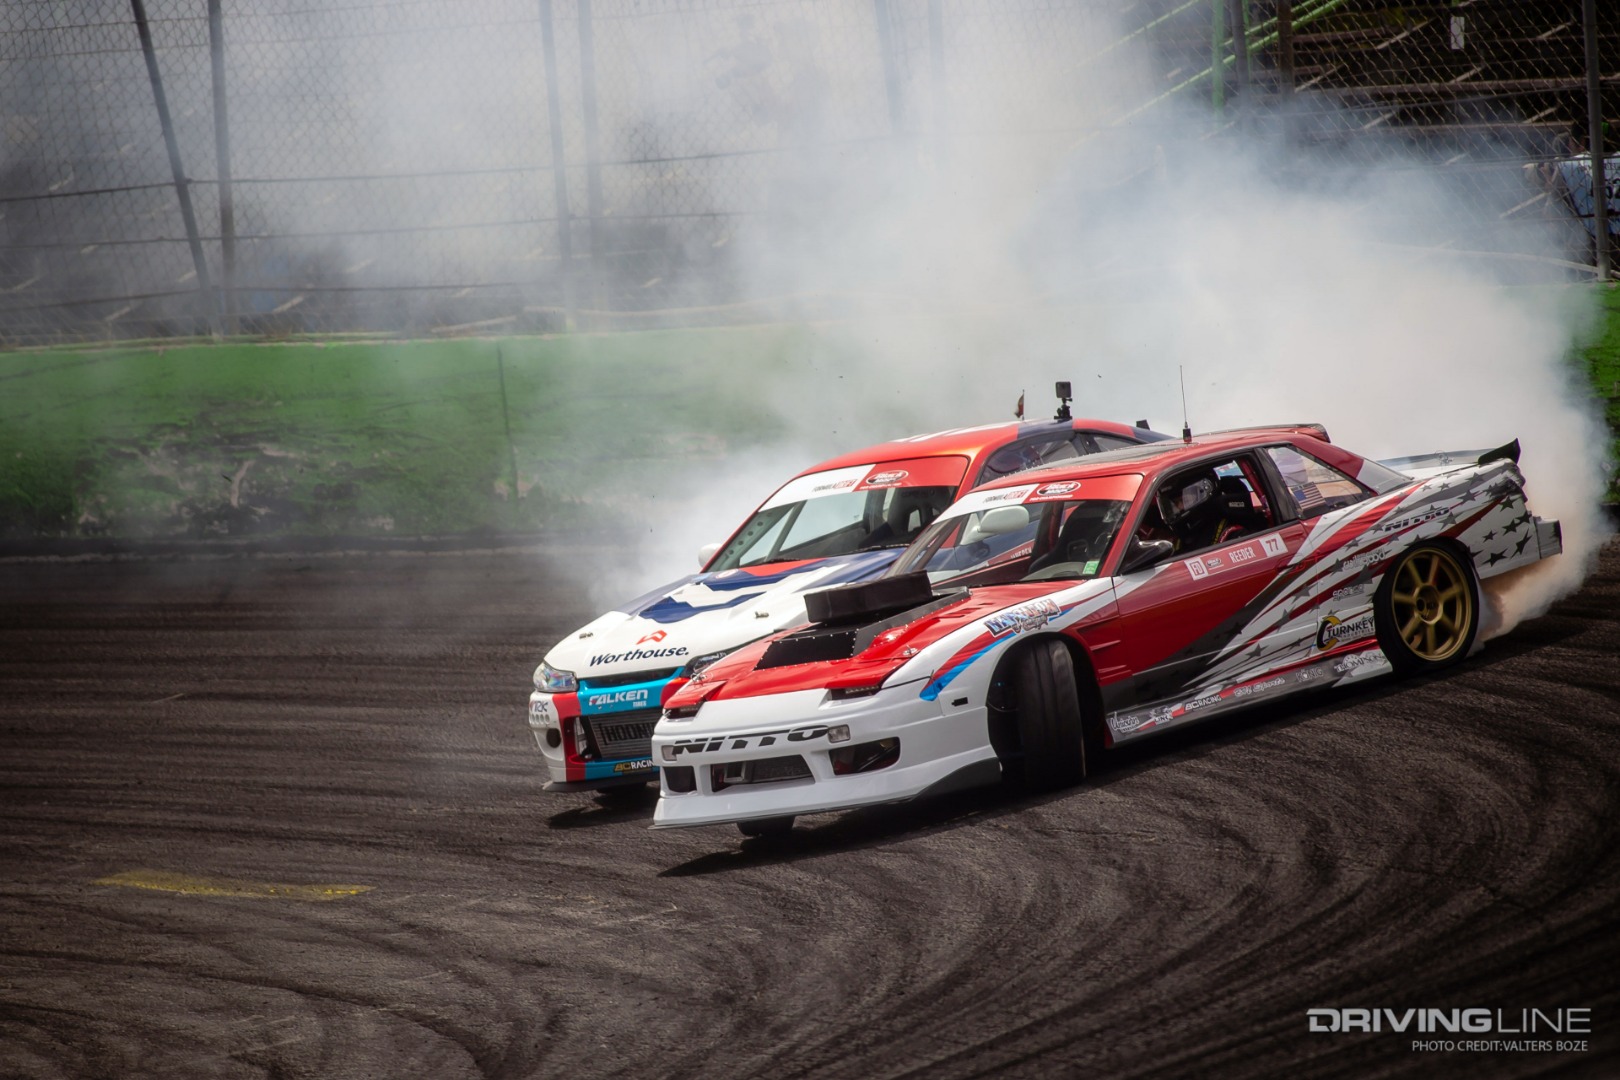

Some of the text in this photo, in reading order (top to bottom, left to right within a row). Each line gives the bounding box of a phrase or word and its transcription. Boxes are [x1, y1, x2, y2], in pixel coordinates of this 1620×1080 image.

[1384, 507, 1449, 532] NITTO
[1228, 546, 1256, 563] REEDER
[1265, 538, 1279, 552] 77
[1325, 618, 1374, 639] TURNKEY
[588, 690, 648, 706] FALKEN
[672, 725, 828, 755] NITTO
